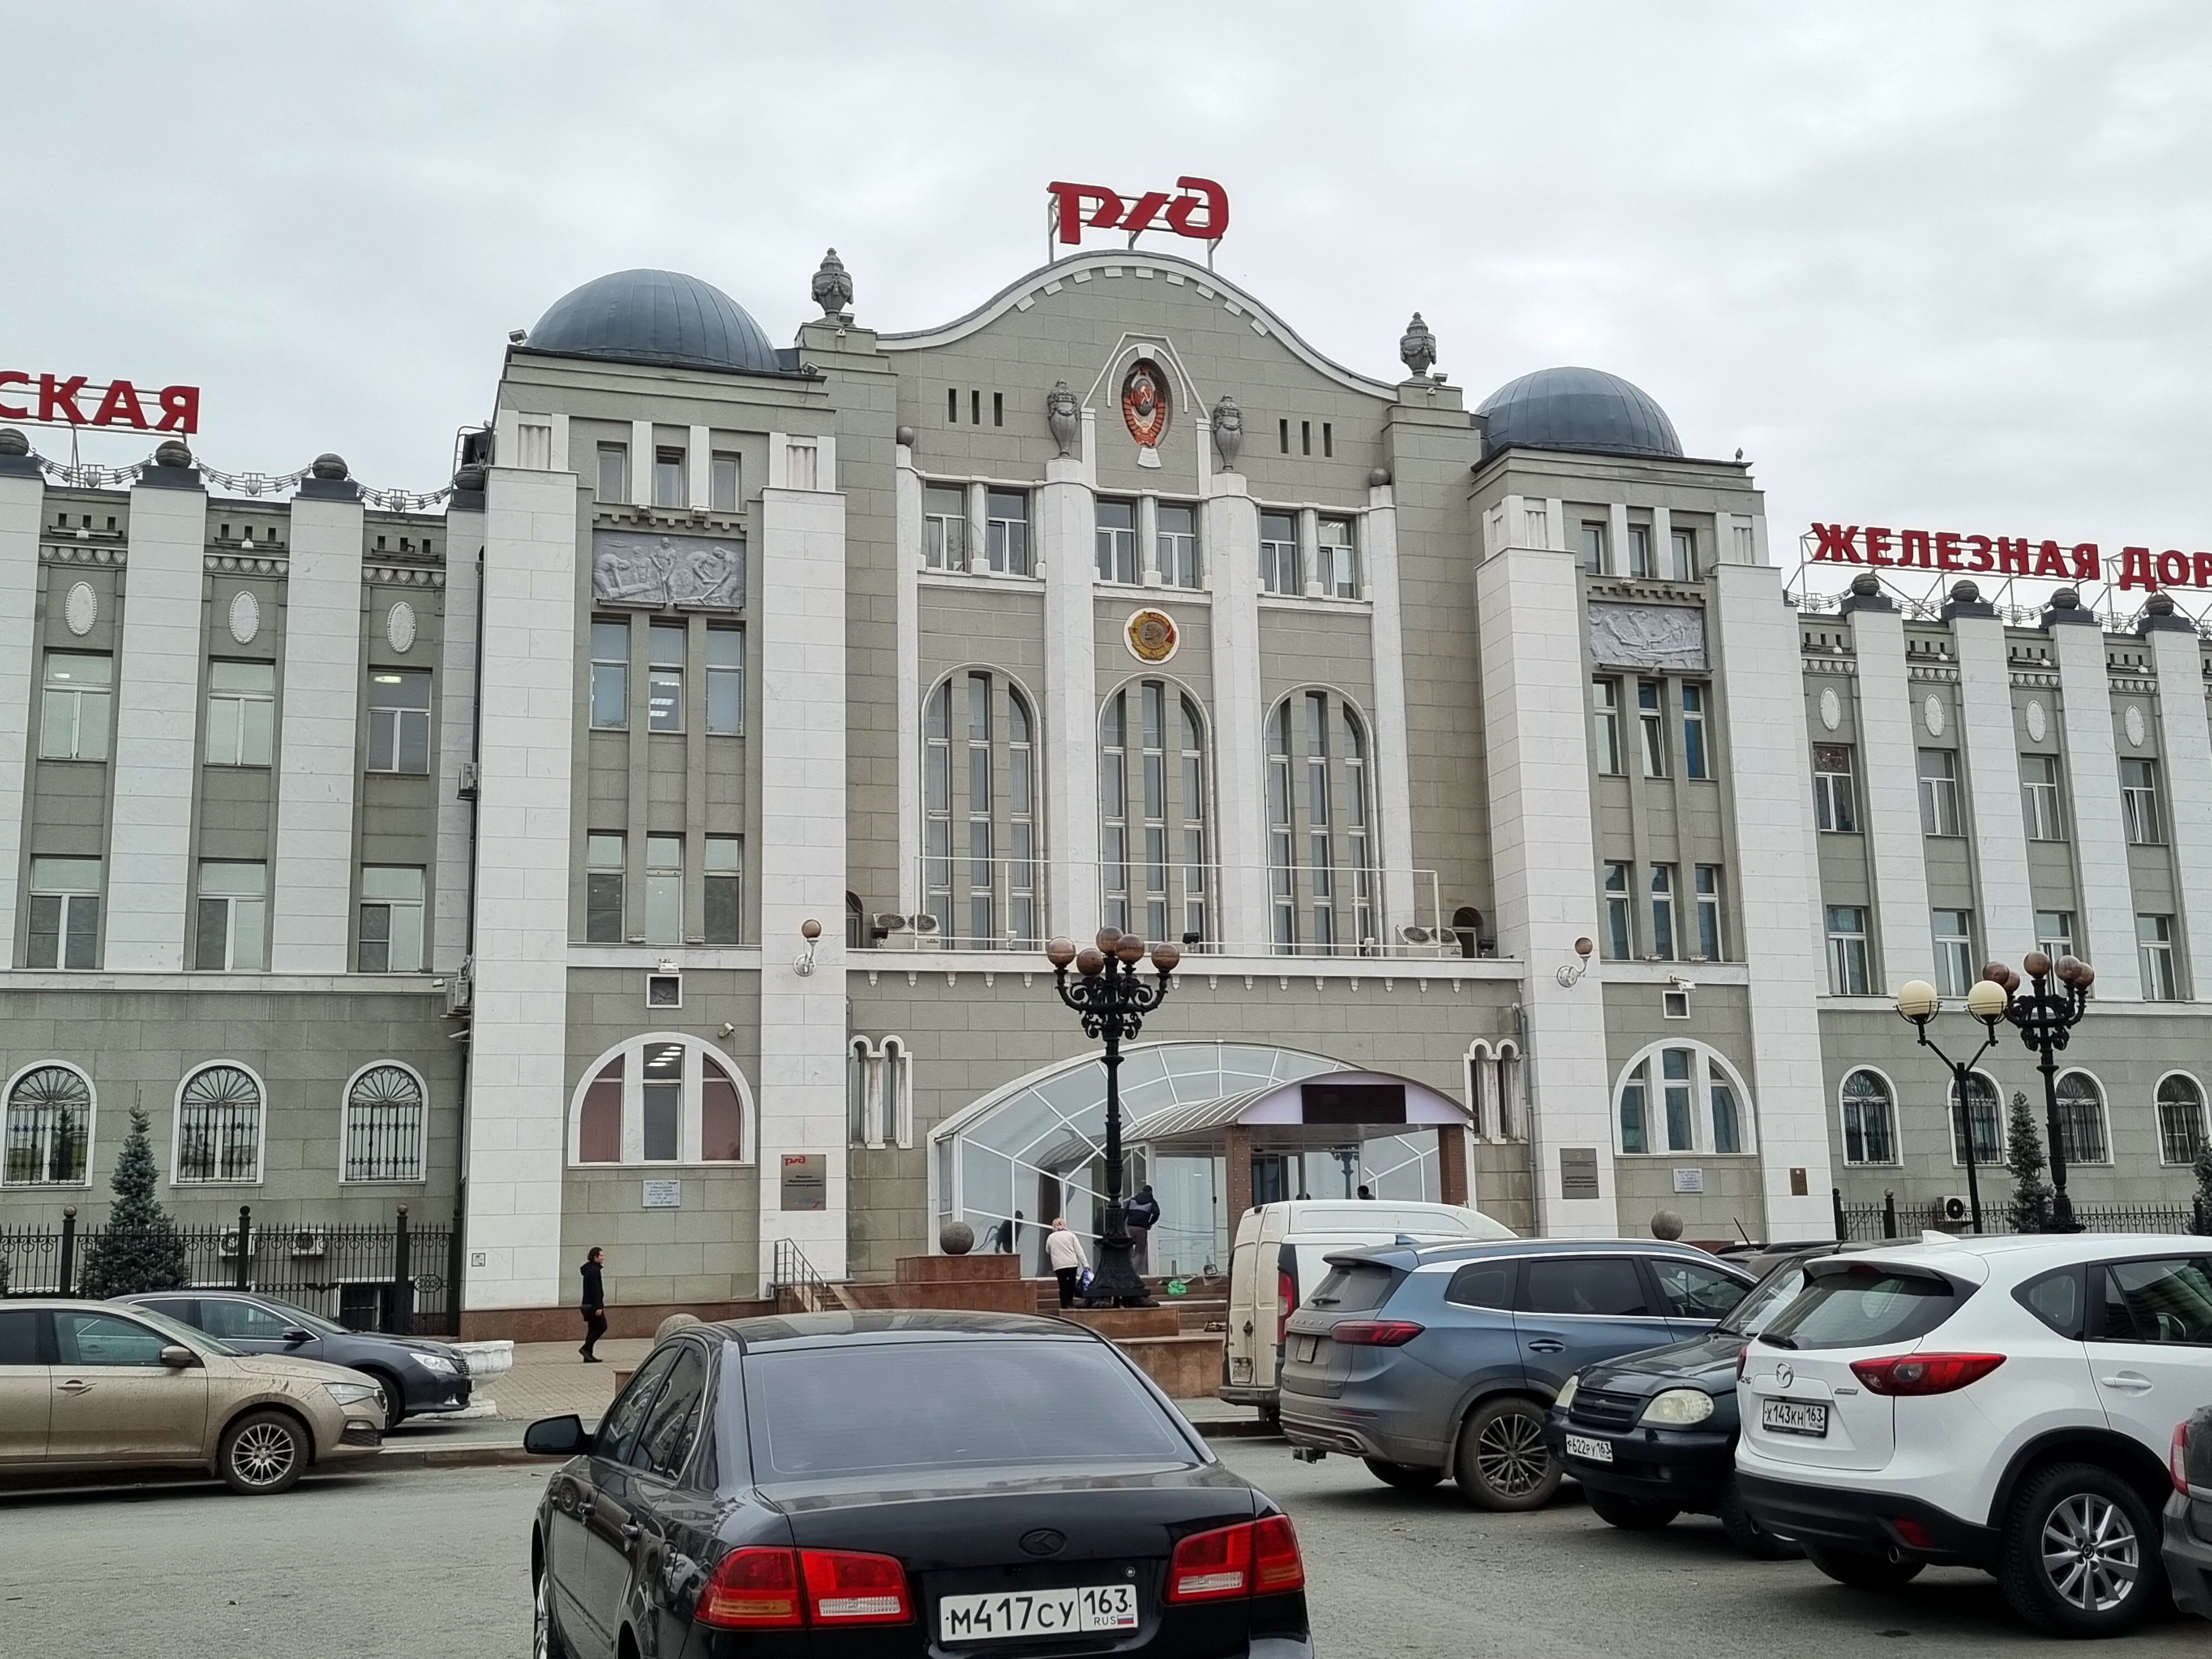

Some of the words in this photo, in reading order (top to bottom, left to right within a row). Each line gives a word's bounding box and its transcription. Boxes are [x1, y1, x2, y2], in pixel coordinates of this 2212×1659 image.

[1811, 522, 2100, 580] ЖЕЛЕЗНАЯ
[2119, 546, 2212, 592] ДОР
[1767, 1404, 1804, 1426] Х143КН
[1806, 1407, 1822, 1423] 163
[1596, 1442, 1611, 1455] 163
[951, 1596, 1074, 1635] М417СУ
[1084, 1588, 1128, 1615] 163
[1093, 1616, 1116, 1626] RUS
